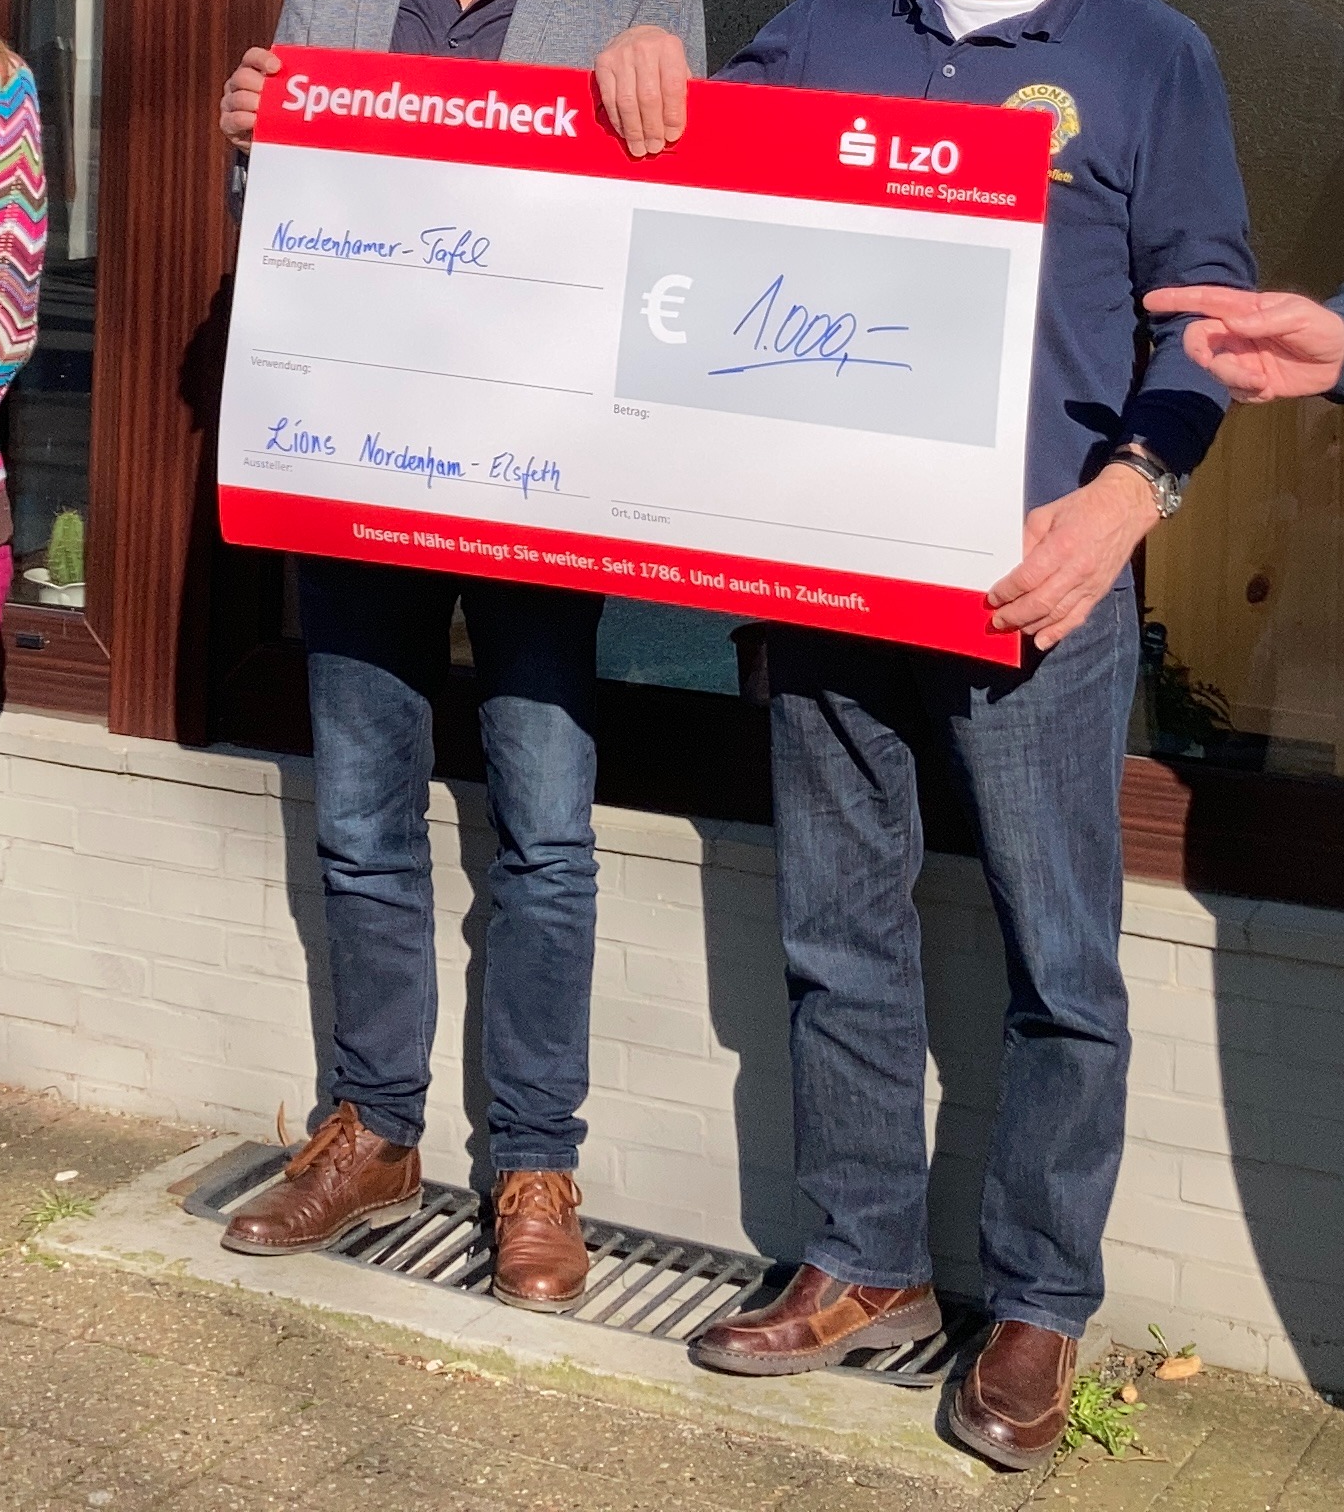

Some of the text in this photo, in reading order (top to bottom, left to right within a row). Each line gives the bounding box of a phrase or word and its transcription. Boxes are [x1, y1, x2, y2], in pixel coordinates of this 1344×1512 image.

[281, 74, 579, 138] Spendenscheck
[1022, 86, 1069, 106] LIONS
[889, 136, 960, 175] LzO
[886, 181, 1017, 207] meine Sparkasse
[262, 255, 315, 272] Empfänger:
[639, 273, 695, 345] €
[250, 355, 312, 375] Verwendung:
[613, 403, 650, 420] Betrag:
[266, 417, 337, 456] Lions
[243, 456, 293, 473] Aussteller:
[611, 506, 671, 525] Ort, Datum:
[352, 523, 871, 613] Unsere Nähe bringt Sie weiter. Seit 1786. Und auch in Zukunft.
